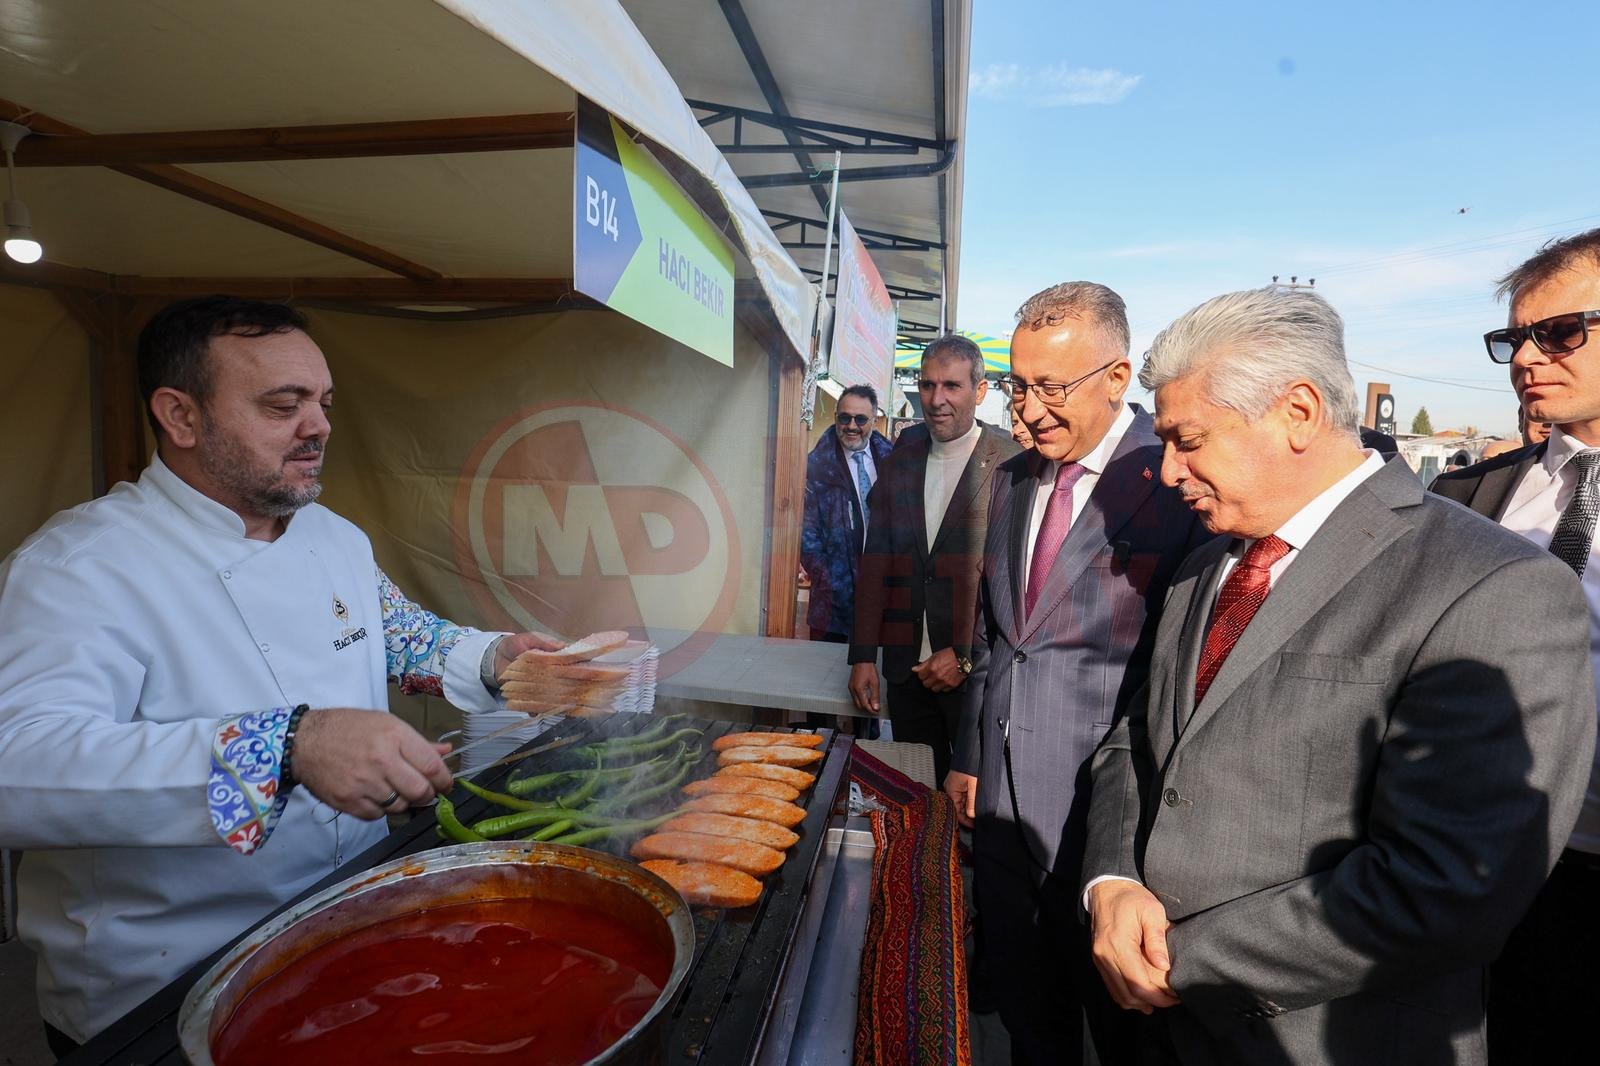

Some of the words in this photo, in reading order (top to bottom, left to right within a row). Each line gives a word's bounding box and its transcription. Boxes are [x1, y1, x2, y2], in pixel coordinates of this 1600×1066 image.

[586, 175, 619, 242] B14
[659, 237, 691, 295] HACI
[694, 266, 725, 319] BEKİR
